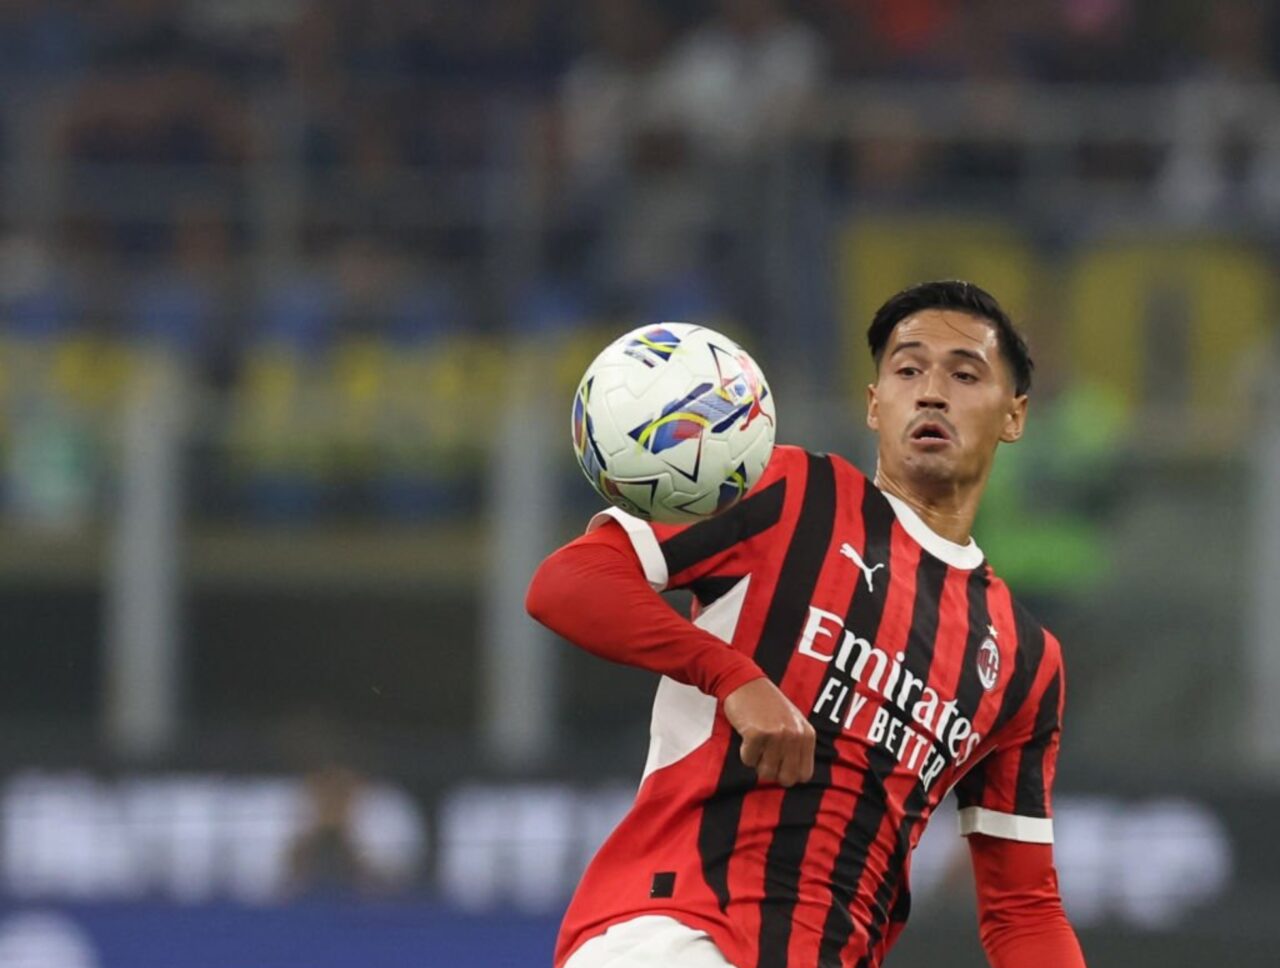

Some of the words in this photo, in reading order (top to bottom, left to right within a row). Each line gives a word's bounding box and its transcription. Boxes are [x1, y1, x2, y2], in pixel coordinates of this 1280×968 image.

[798, 605, 981, 767] Emirates
[812, 676, 867, 730] FLY
[867, 705, 946, 793] BETTER
